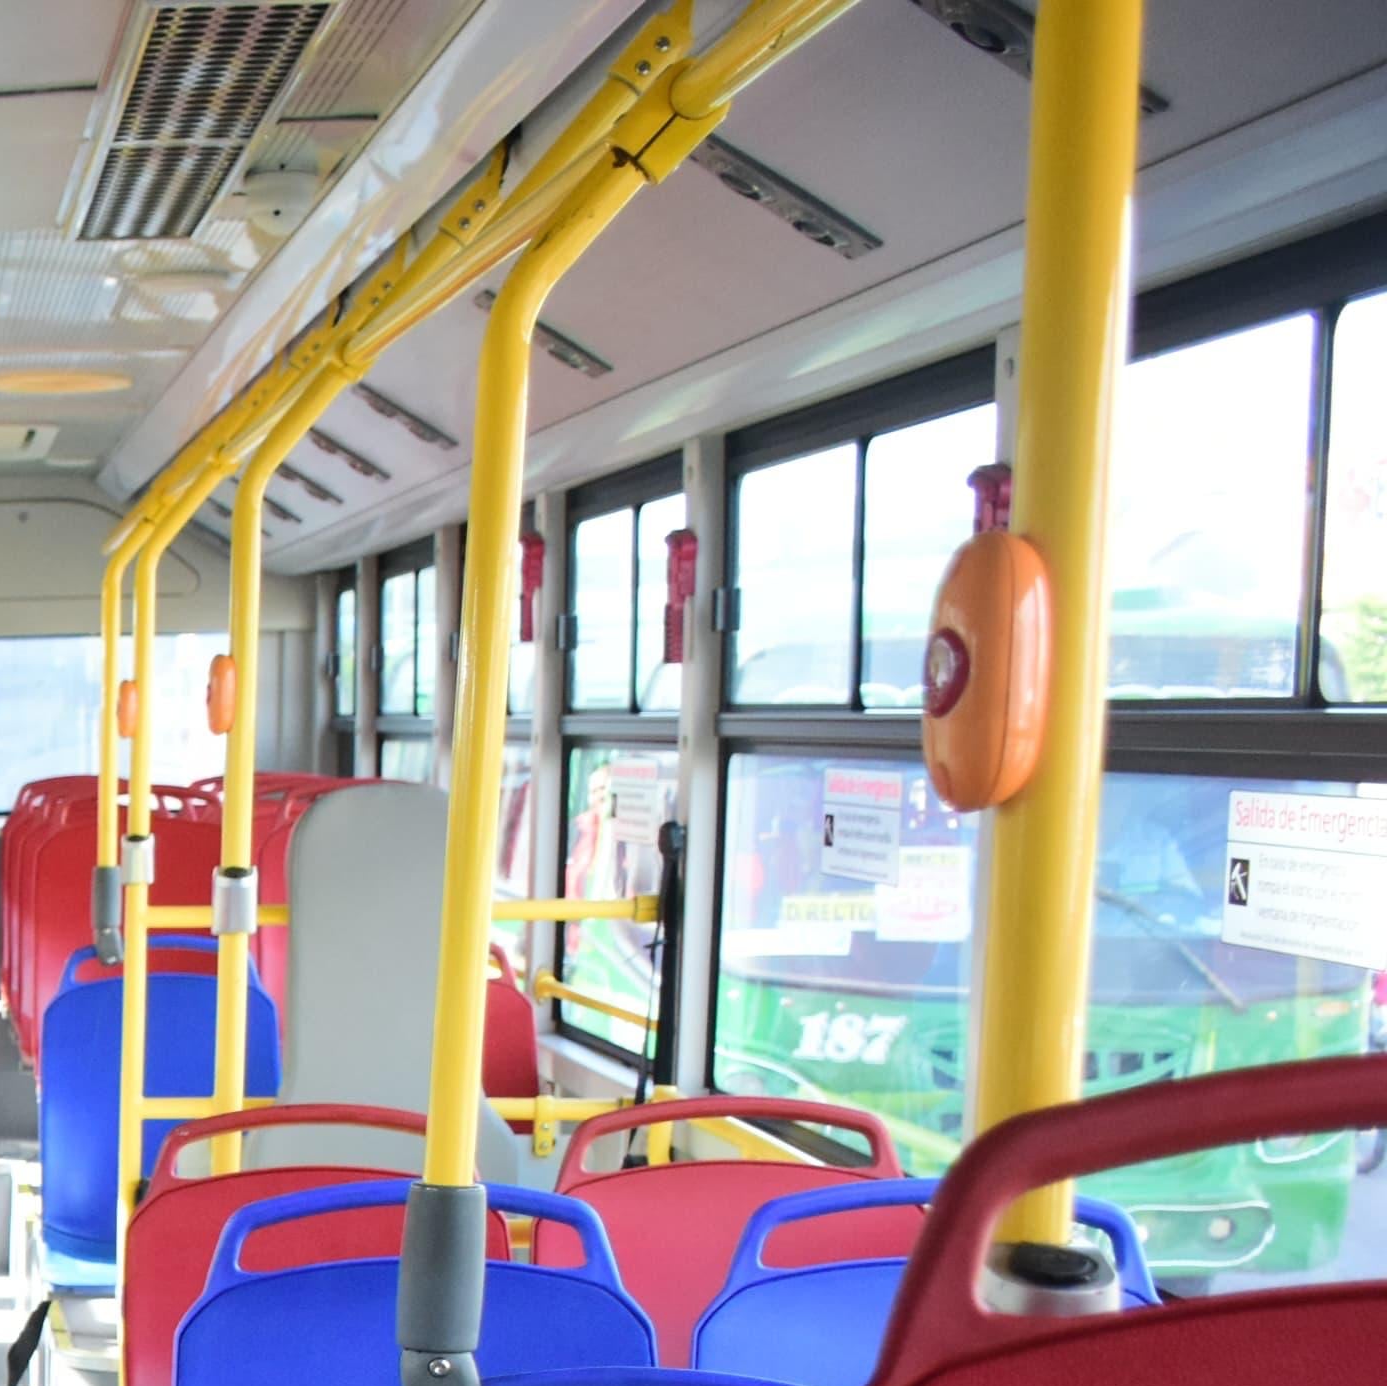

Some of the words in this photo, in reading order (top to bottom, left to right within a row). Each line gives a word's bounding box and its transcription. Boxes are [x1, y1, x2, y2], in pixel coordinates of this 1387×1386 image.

[1235, 798, 1276, 829] Salida
[1279, 800, 1296, 831] de
[791, 1010, 910, 1065] 187
